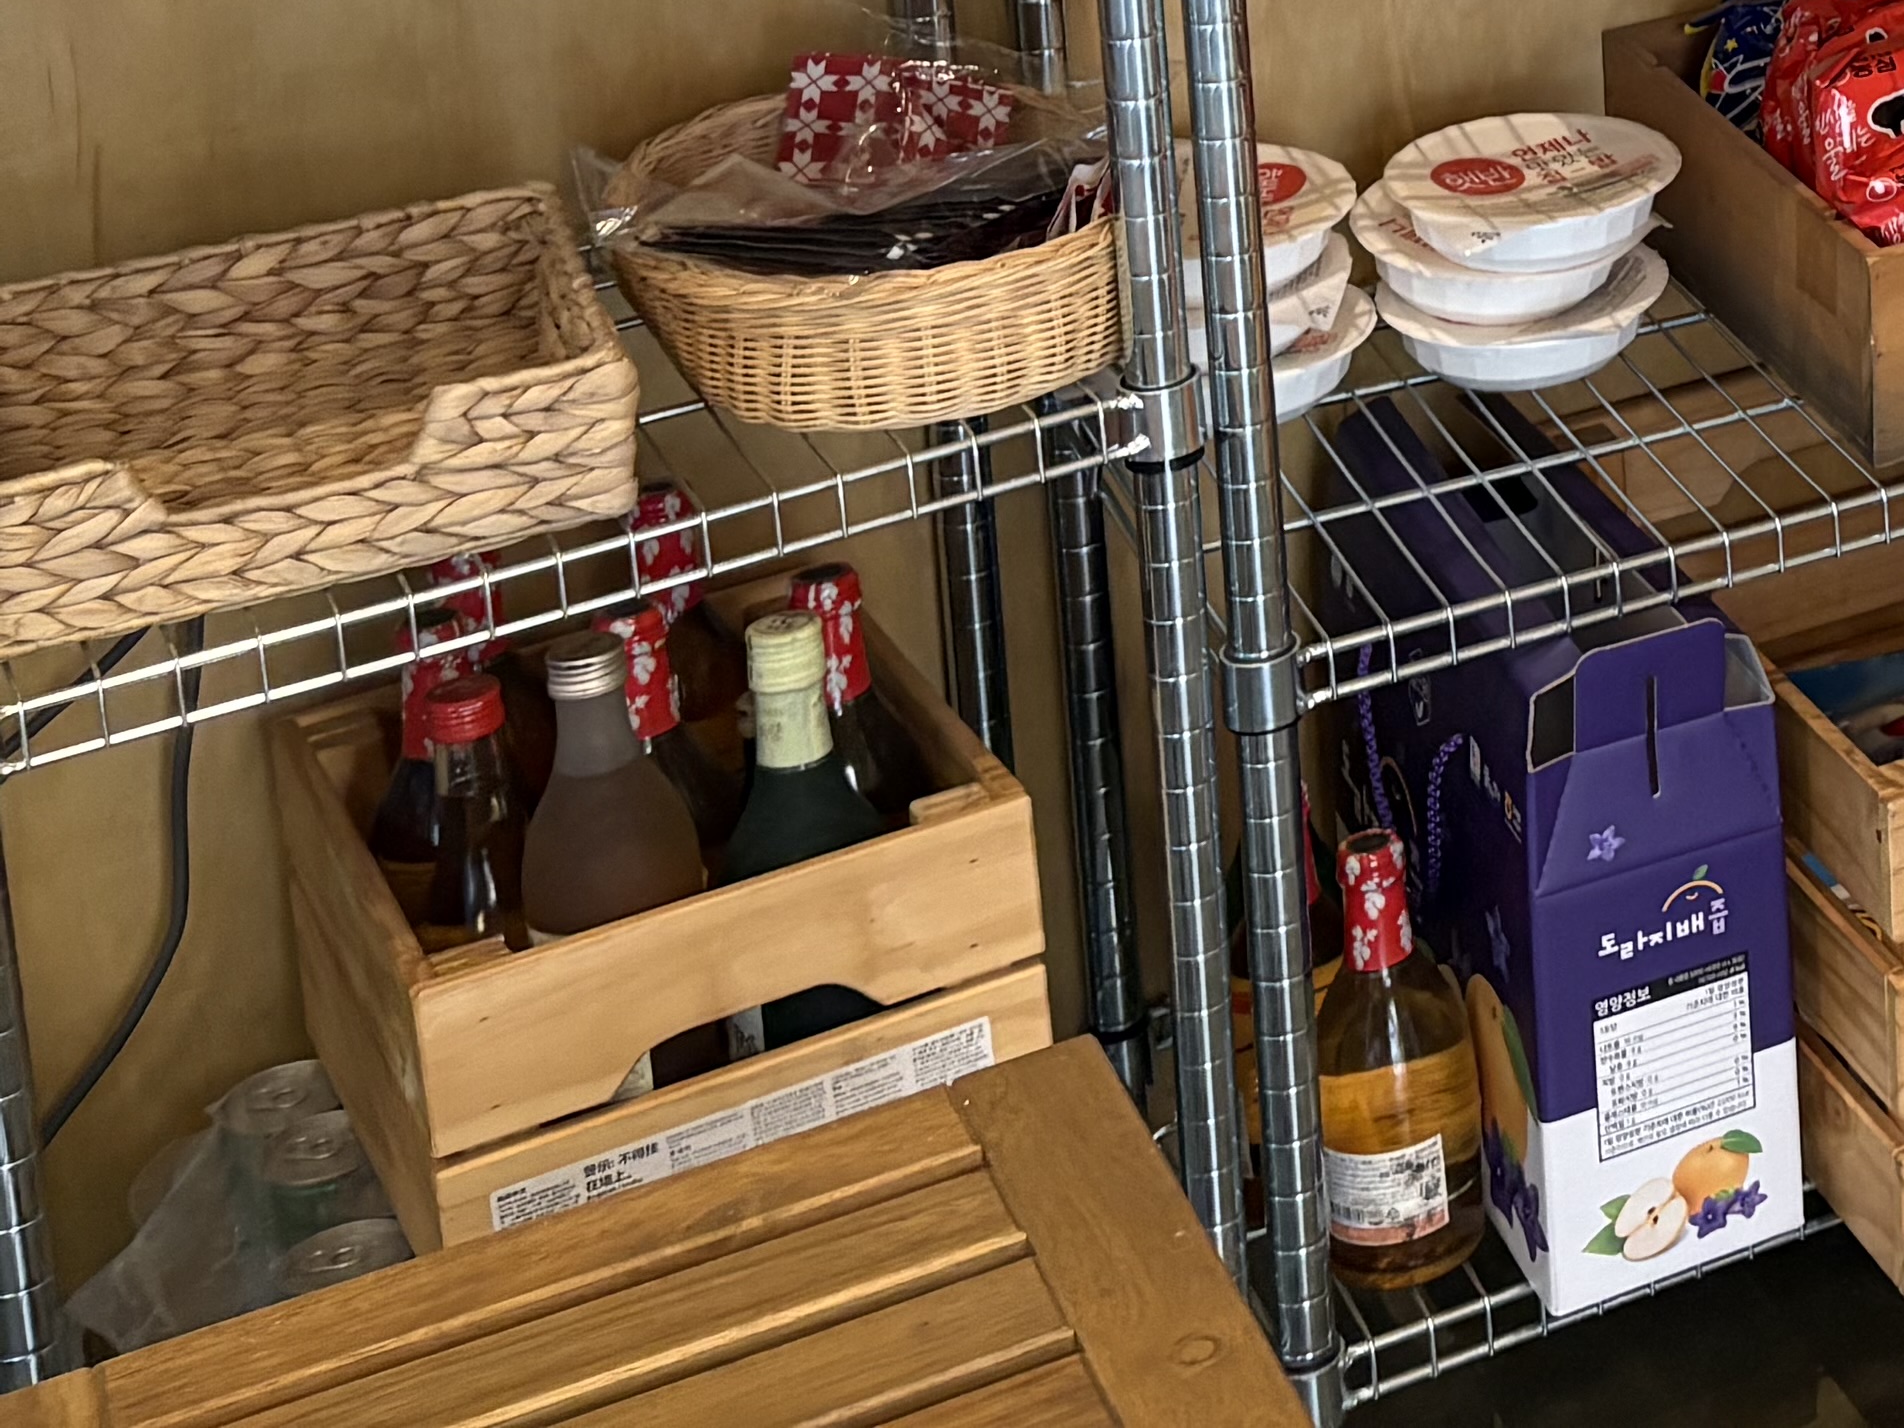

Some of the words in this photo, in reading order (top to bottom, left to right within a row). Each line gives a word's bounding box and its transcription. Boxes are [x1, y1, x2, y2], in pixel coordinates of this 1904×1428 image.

[1512, 128, 1592, 163] 언제나
[1443, 161, 1512, 191] 햇반
[1598, 897, 1729, 961] 도라지배즙
[1594, 985, 1652, 1017] 영양정보
